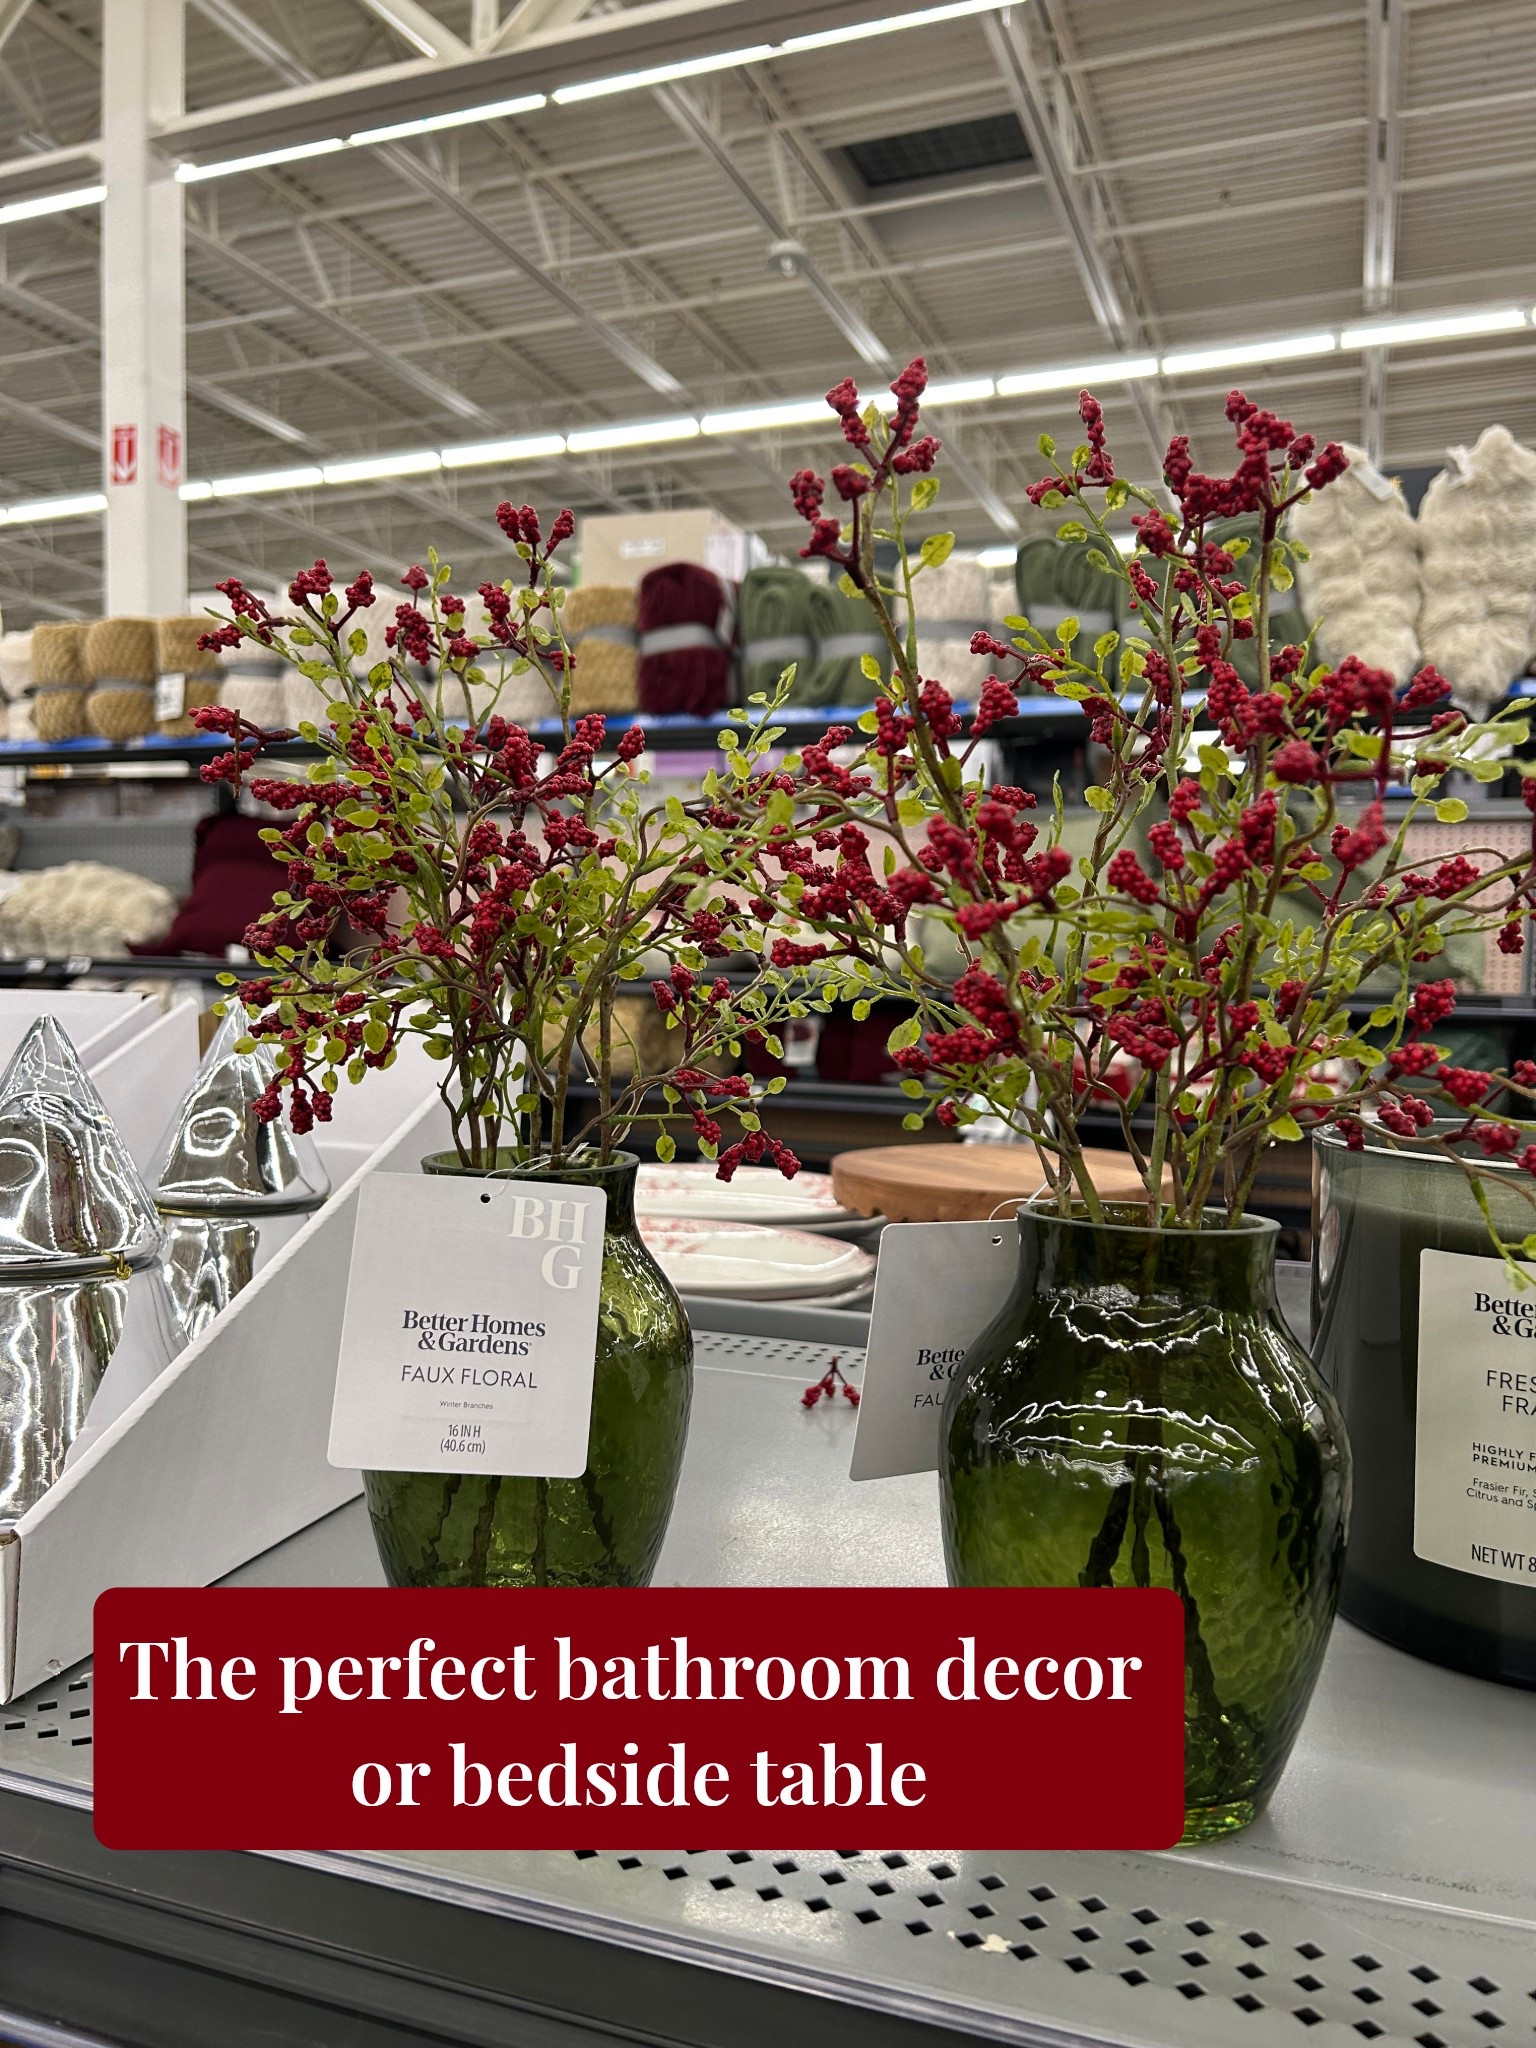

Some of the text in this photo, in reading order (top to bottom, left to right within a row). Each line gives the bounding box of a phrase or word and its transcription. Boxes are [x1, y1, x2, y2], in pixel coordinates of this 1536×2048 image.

[506, 1195, 592, 1244] BH
[541, 1245, 584, 1289] G
[402, 1310, 546, 1337] Better Homes
[916, 1348, 967, 1366] Bette
[401, 1365, 538, 1389] FAUX FLORAL
[440, 1400, 493, 1410] Winter Branches
[449, 1424, 481, 1438] 16 IN H
[440, 1438, 486, 1455] (40.6 cm)
[1472, 1442, 1524, 1460] HIGHLY
[1466, 1487, 1499, 1503] Citrus
[1501, 1496, 1523, 1507] and
[1473, 1477, 1509, 1493] Frasier
[1513, 1485, 1529, 1498] Fir,
[1471, 1543, 1498, 1565] NET
[1500, 1550, 1526, 1571] WT
